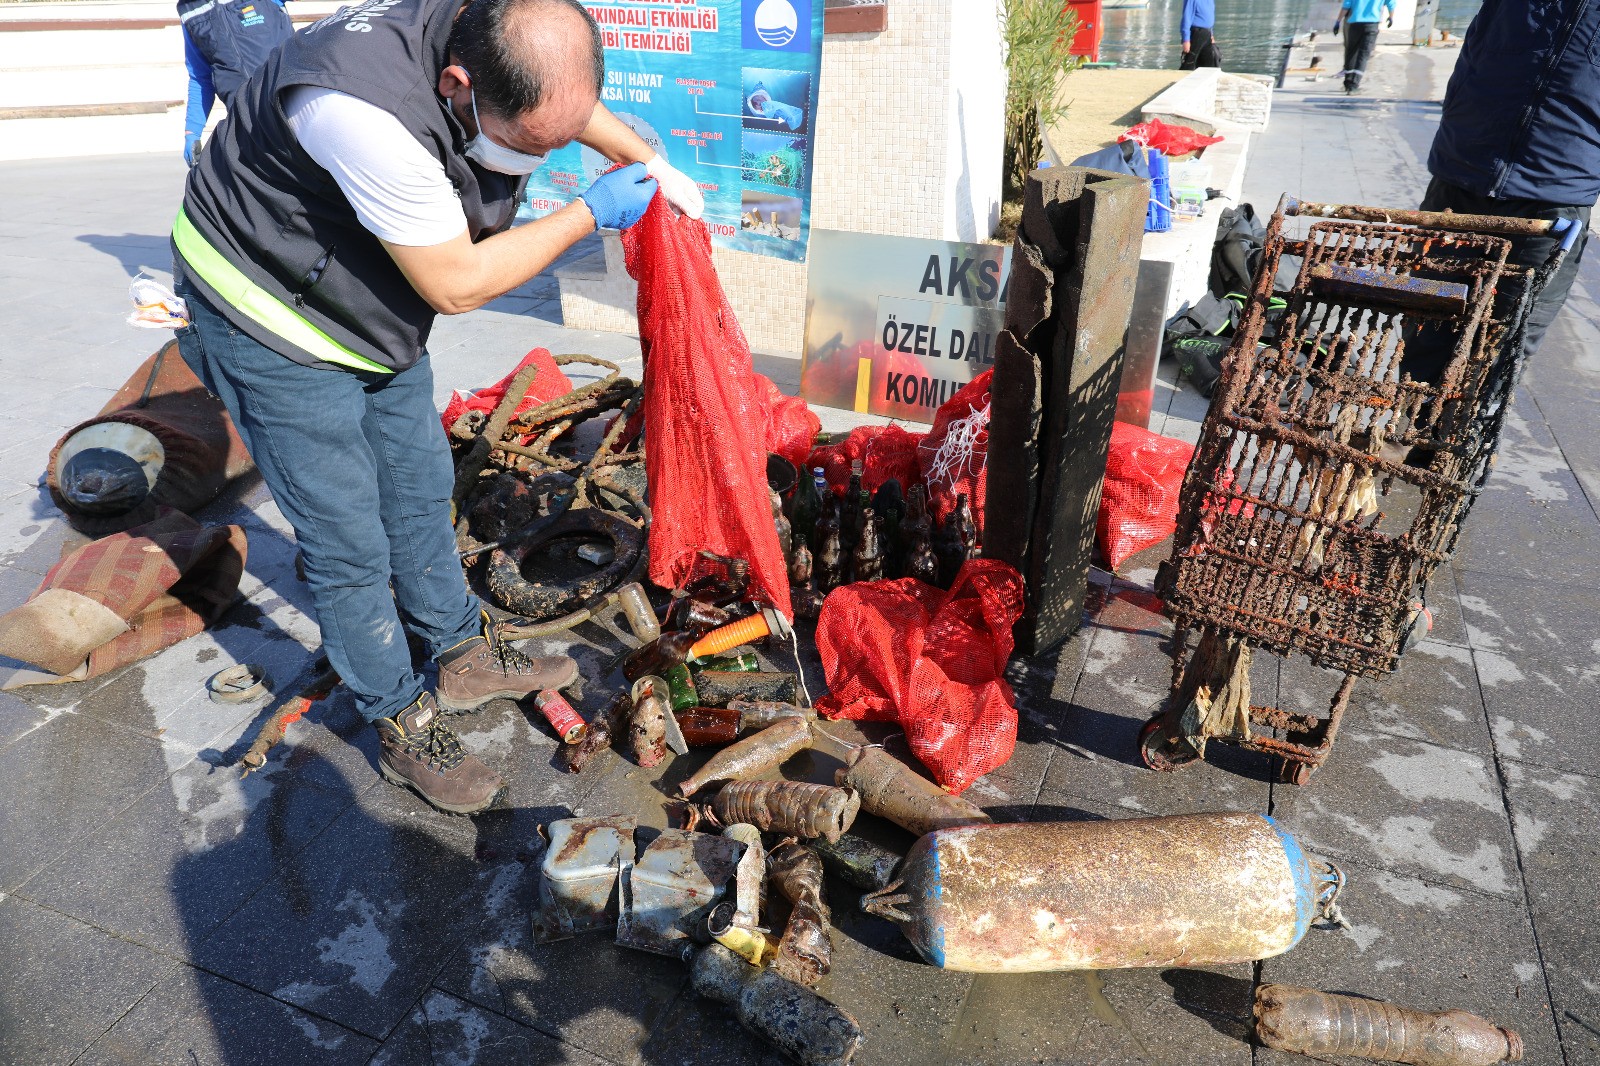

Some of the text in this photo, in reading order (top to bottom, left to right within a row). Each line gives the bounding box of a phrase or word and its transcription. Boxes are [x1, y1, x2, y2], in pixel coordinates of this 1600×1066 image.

[586, 8, 717, 30] RKINDALI ETKİNLİĞİ
[602, 28, 690, 52] İBİ TEMİZLİĞİ
[607, 70, 663, 88] SU HAYAT
[600, 86, 651, 103] KSA YOK
[532, 199, 549, 209] HER
[706, 222, 735, 237] LIYOR
[919, 254, 1008, 302] AKS
[882, 313, 996, 364] ÖZEL DAL
[885, 371, 968, 408] KOMU
